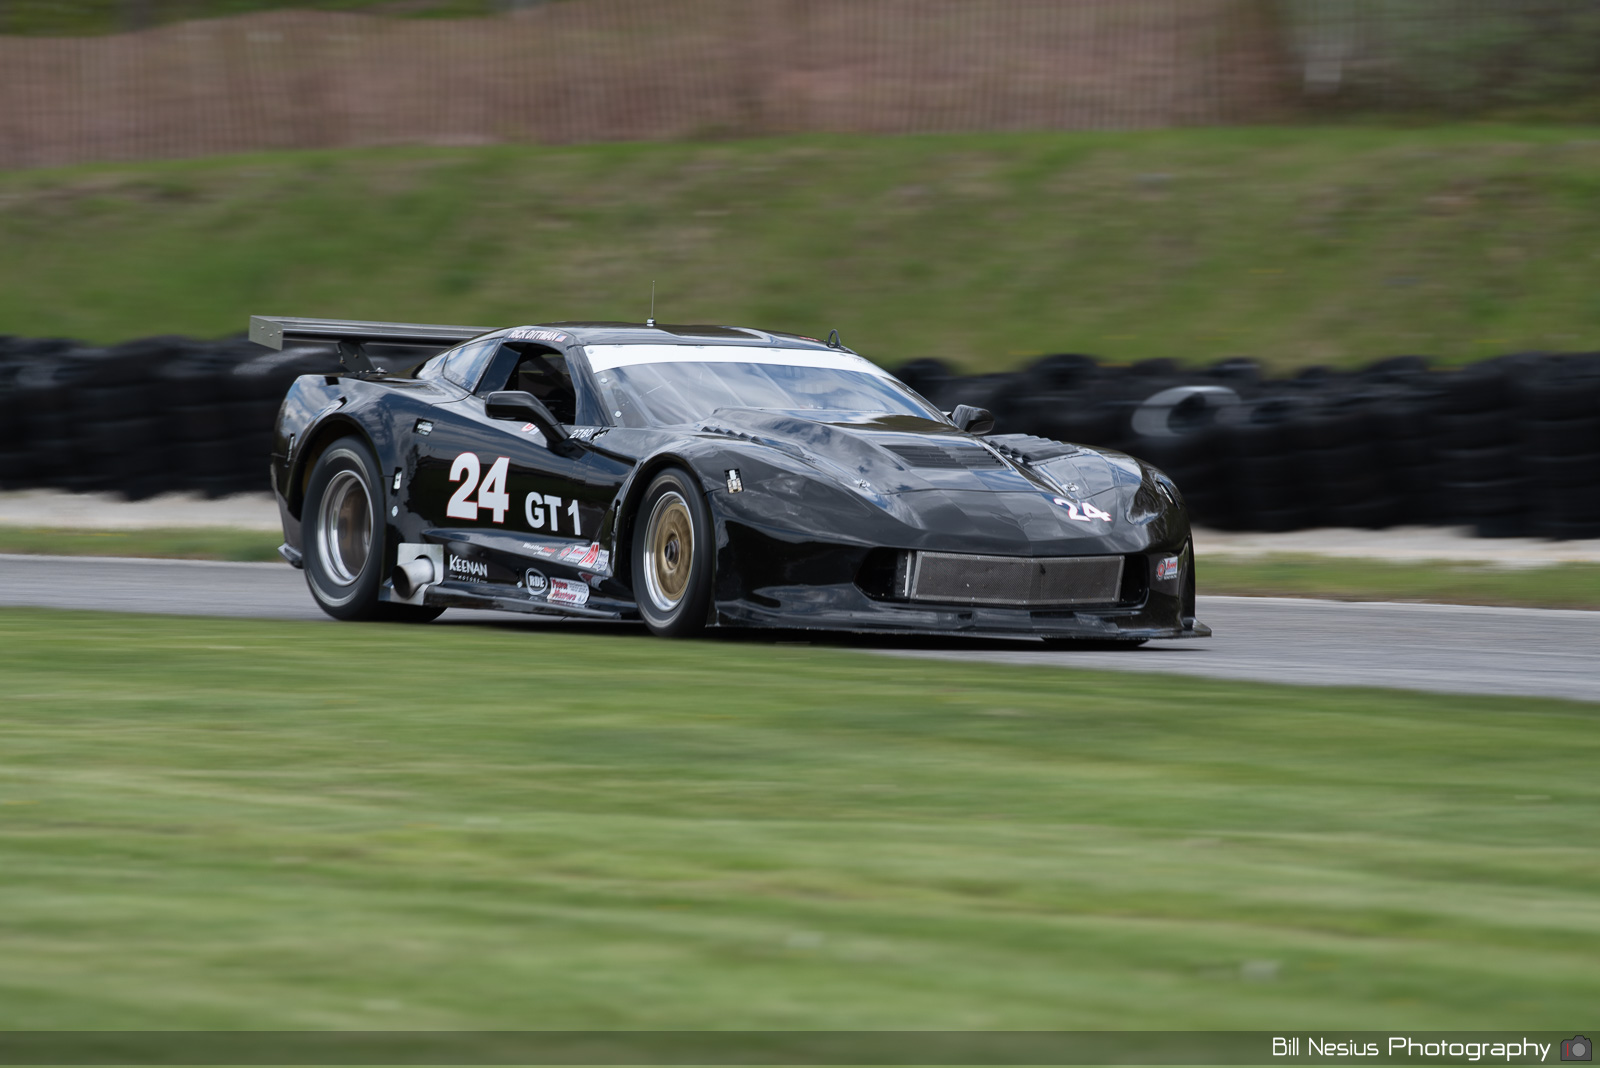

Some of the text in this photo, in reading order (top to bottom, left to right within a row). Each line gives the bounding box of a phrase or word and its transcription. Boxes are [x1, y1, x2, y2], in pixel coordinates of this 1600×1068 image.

[508, 329, 530, 339] RICK
[446, 451, 511, 524] 24
[524, 491, 581, 536] GT 1
[1053, 498, 1112, 522] 24
[449, 554, 488, 578] KEENAN
[529, 575, 545, 588] RDE
